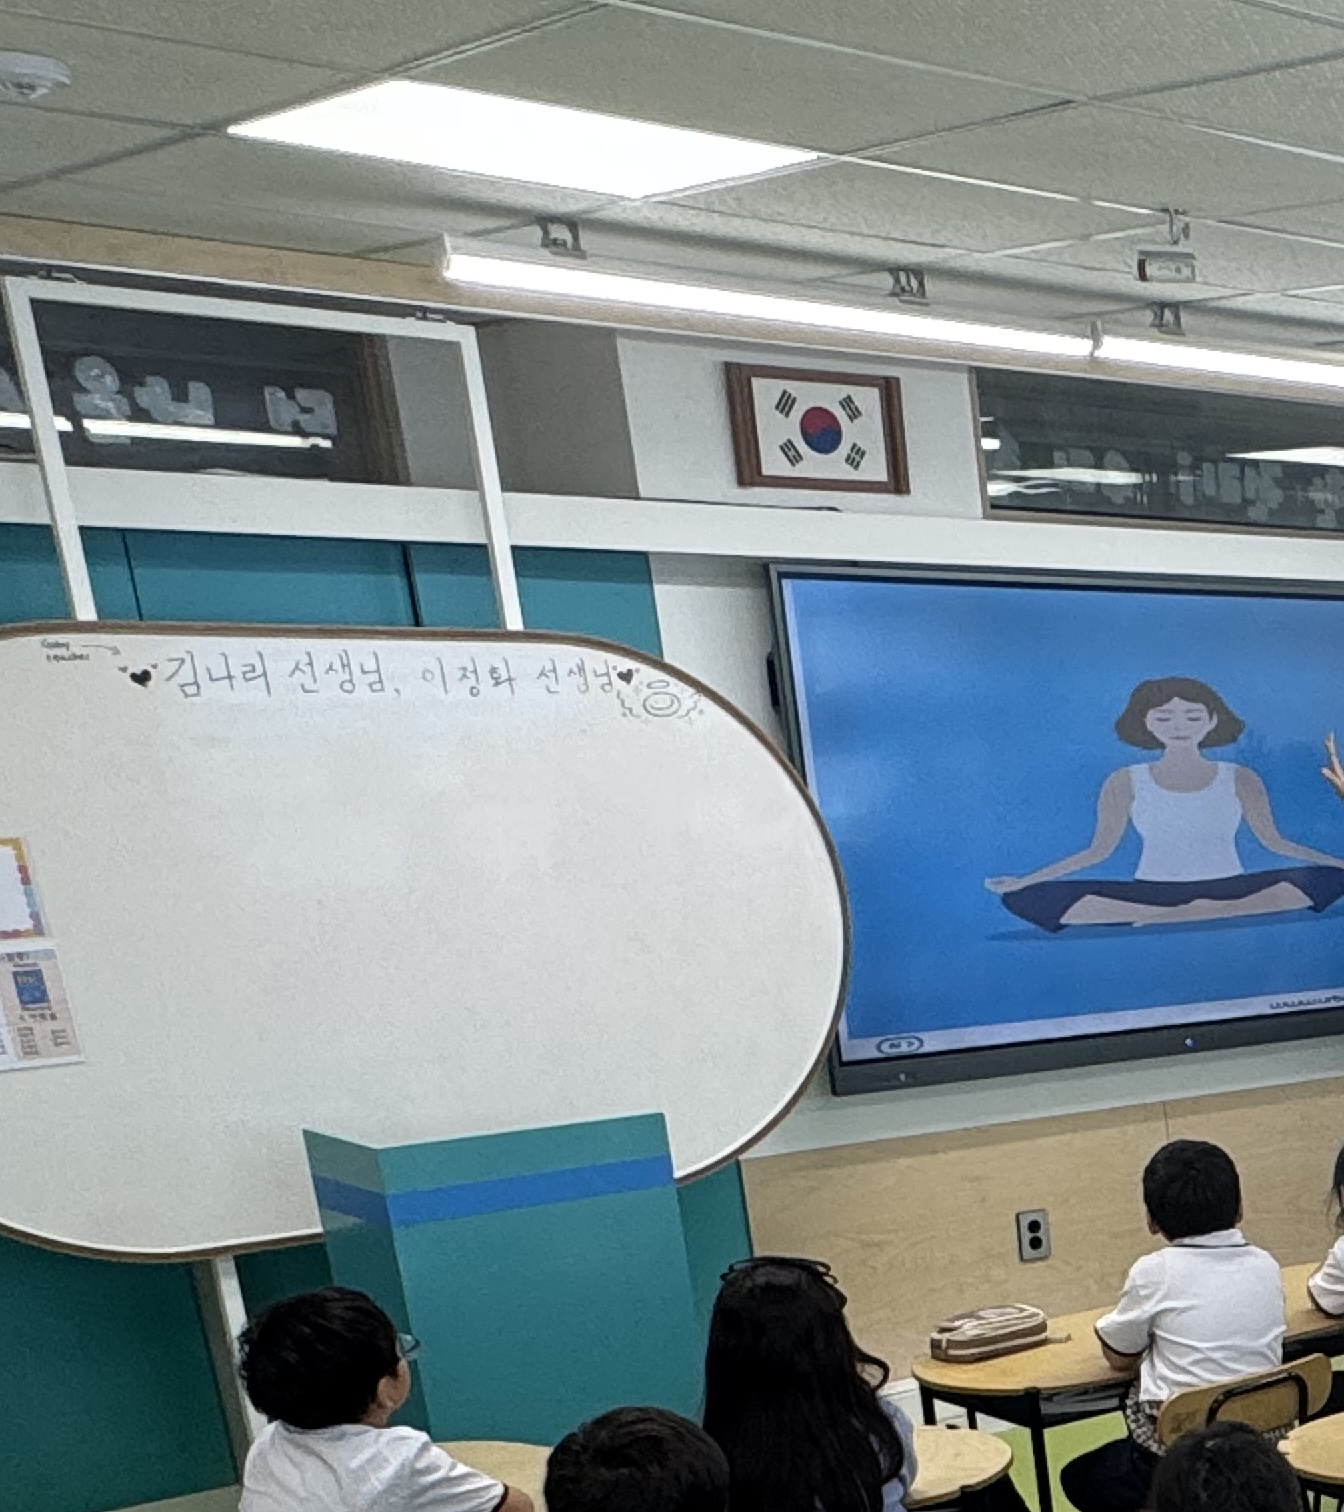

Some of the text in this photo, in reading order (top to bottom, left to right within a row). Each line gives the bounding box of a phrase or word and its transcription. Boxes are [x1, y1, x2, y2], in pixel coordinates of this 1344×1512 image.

[164, 650, 272, 699] 김나리
[420, 656, 517, 698] 이정화
[536, 657, 614, 694] 선생님
